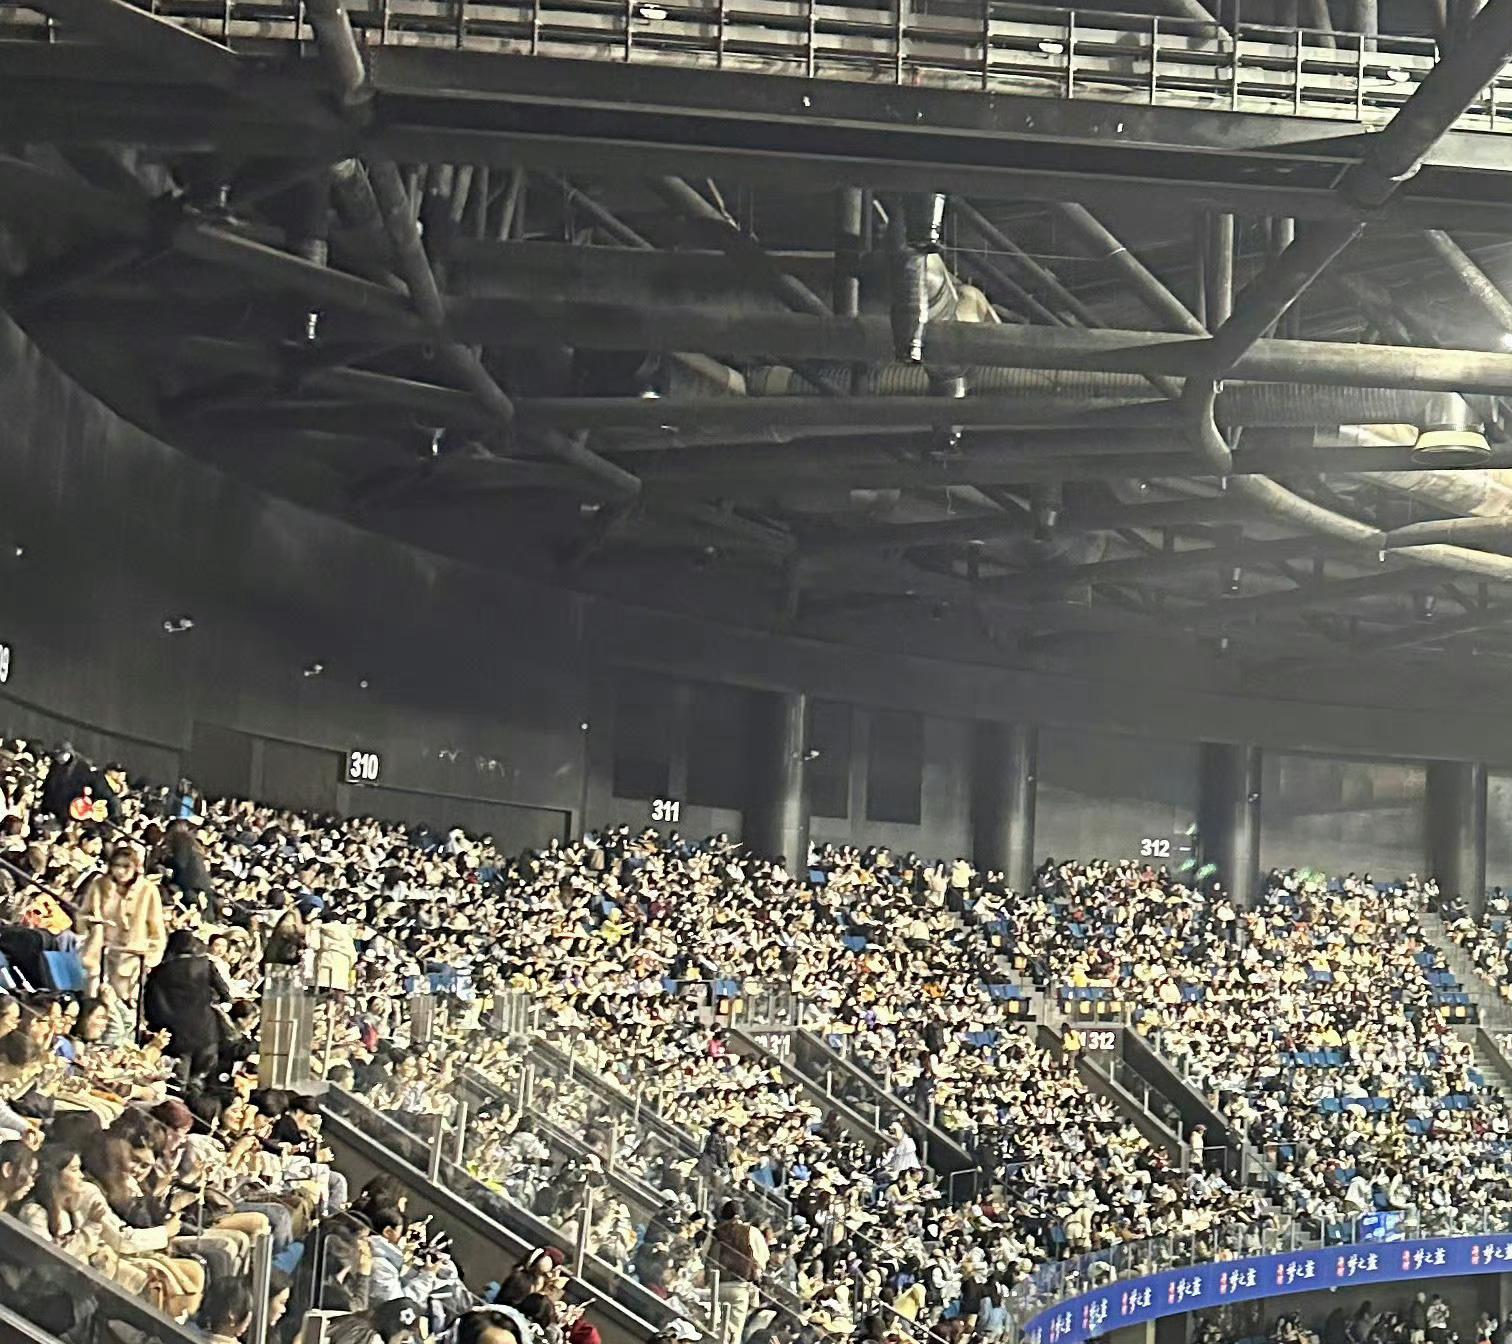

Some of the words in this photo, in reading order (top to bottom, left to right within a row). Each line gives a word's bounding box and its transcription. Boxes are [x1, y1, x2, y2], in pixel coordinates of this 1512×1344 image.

[349, 751, 379, 780] 310
[651, 799, 680, 822] 311
[1140, 838, 1170, 857] 312
[1088, 1031, 1116, 1050] 312
